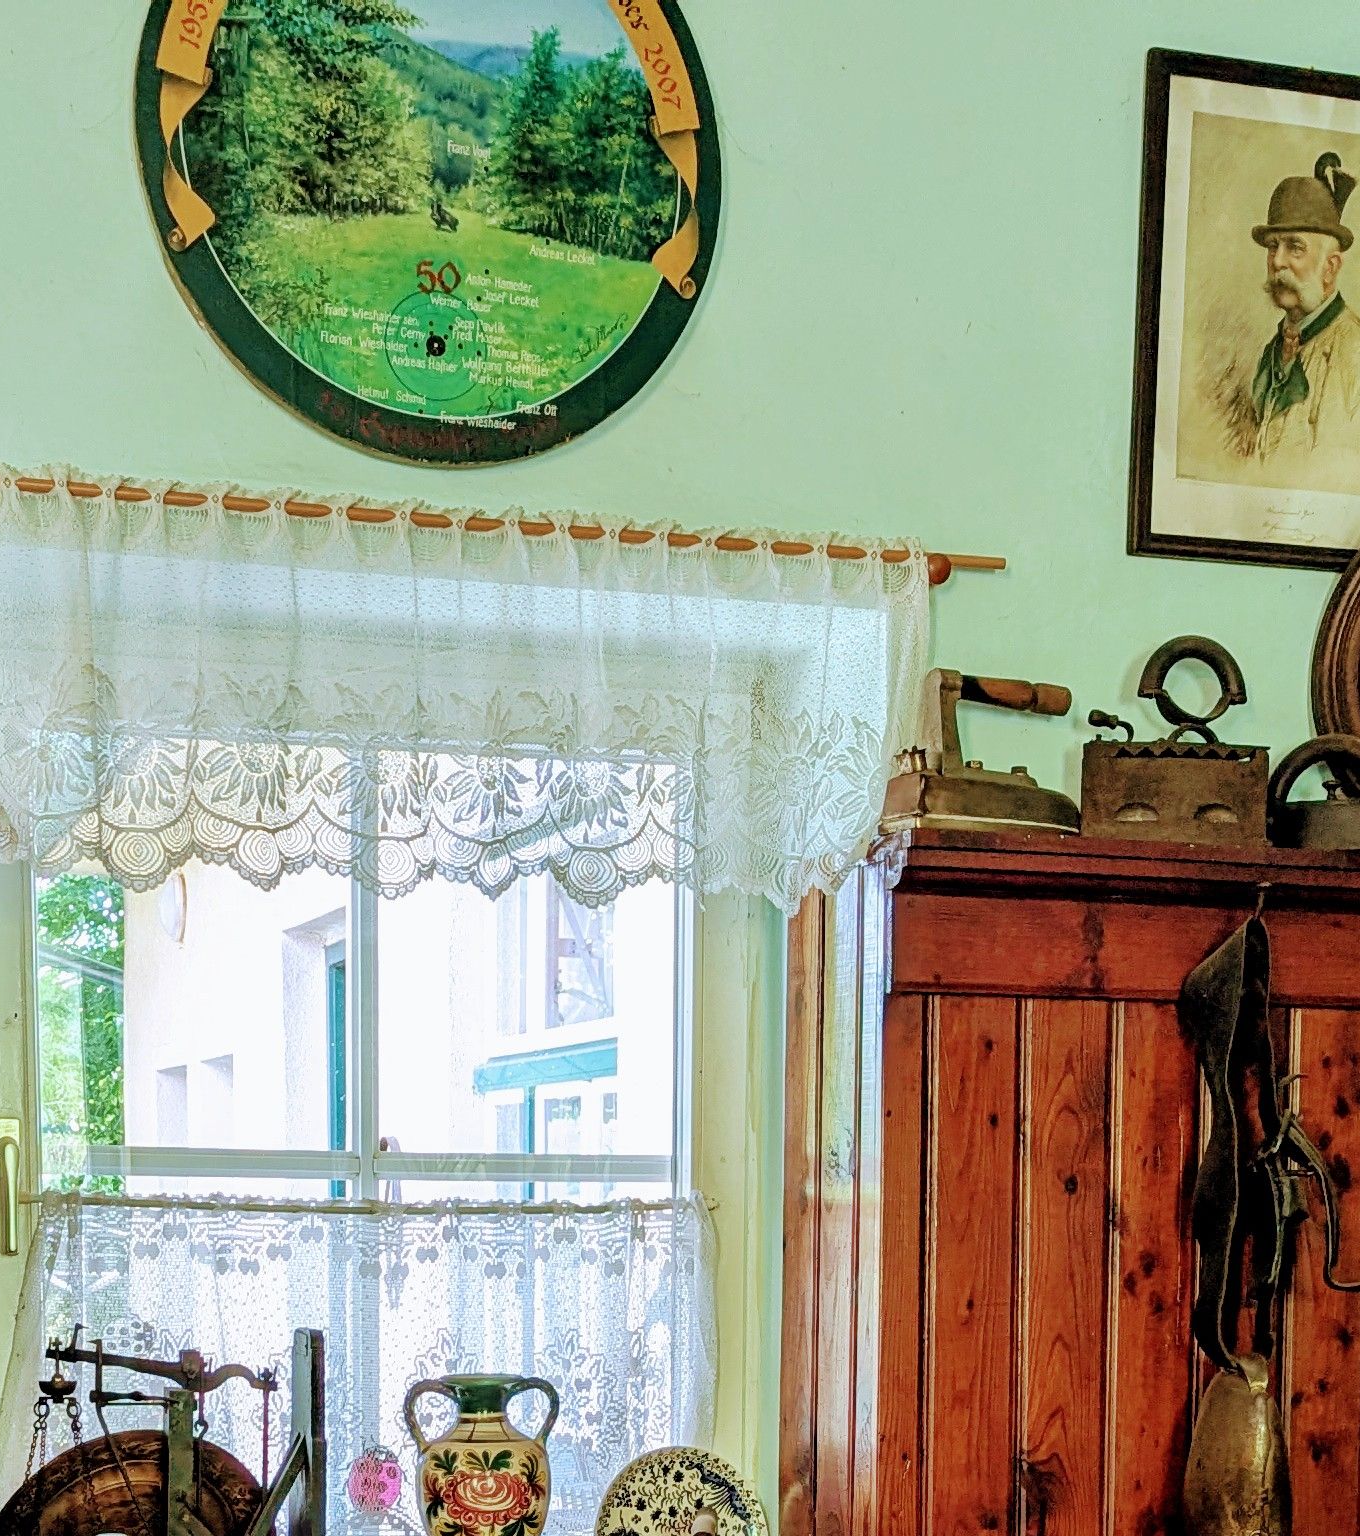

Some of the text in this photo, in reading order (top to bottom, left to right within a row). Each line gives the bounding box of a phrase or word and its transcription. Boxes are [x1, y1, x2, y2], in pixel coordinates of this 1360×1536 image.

[643, 43, 682, 110] 2007
[447, 140, 471, 156] Franz
[529, 244, 565, 258] Andreas
[416, 259, 462, 294] 50
[325, 304, 348, 318] Franz
[372, 323, 396, 337] Peter
[320, 331, 409, 353] Florian Wieshaider
[391, 356, 426, 370] Andreas
[358, 385, 428, 406] Helmut Schmid
[516, 400, 542, 416] Franz
[440, 410, 517, 431] Franz Wieshaider
